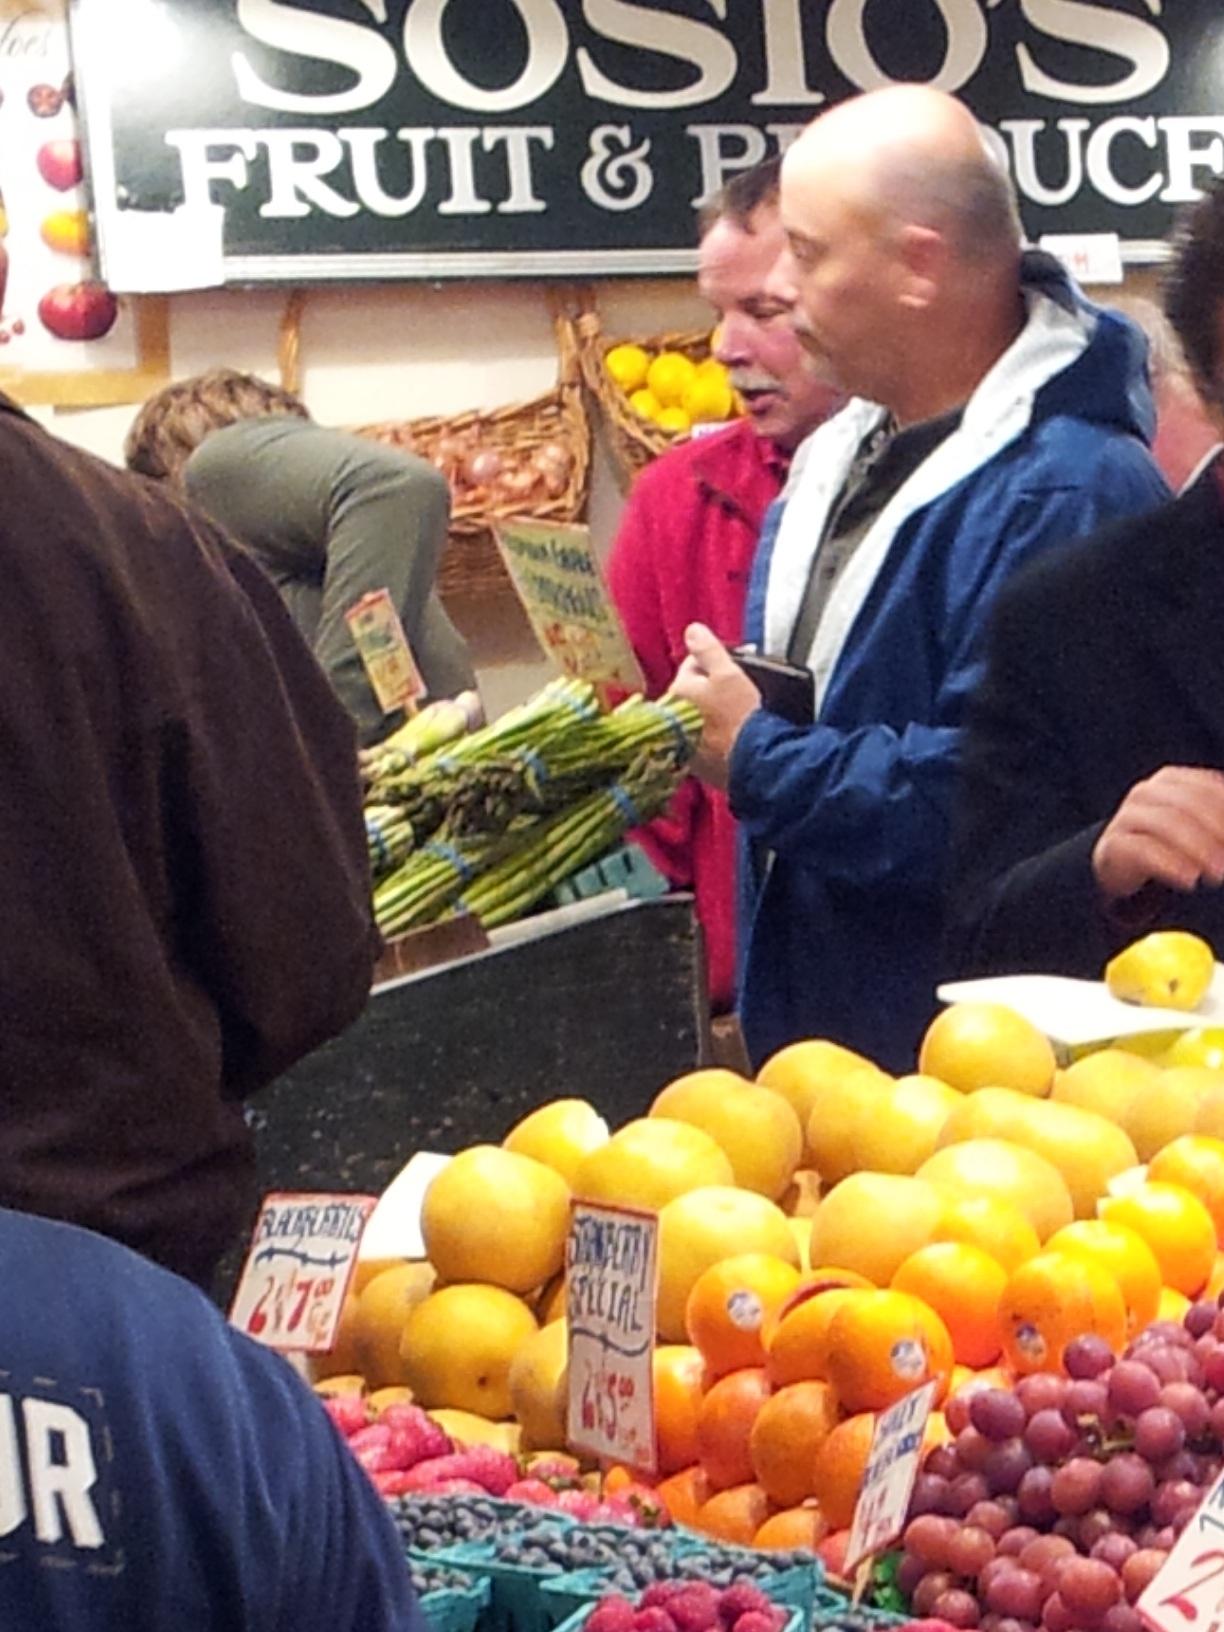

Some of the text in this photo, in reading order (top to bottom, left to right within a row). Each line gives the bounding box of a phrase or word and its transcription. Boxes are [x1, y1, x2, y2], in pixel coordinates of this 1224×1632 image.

[231, 0, 1170, 114] SOSIOS
[164, 126, 554, 218] FRUIT
[579, 123, 653, 209] &
[570, 1272, 644, 1333] SPECIAL
